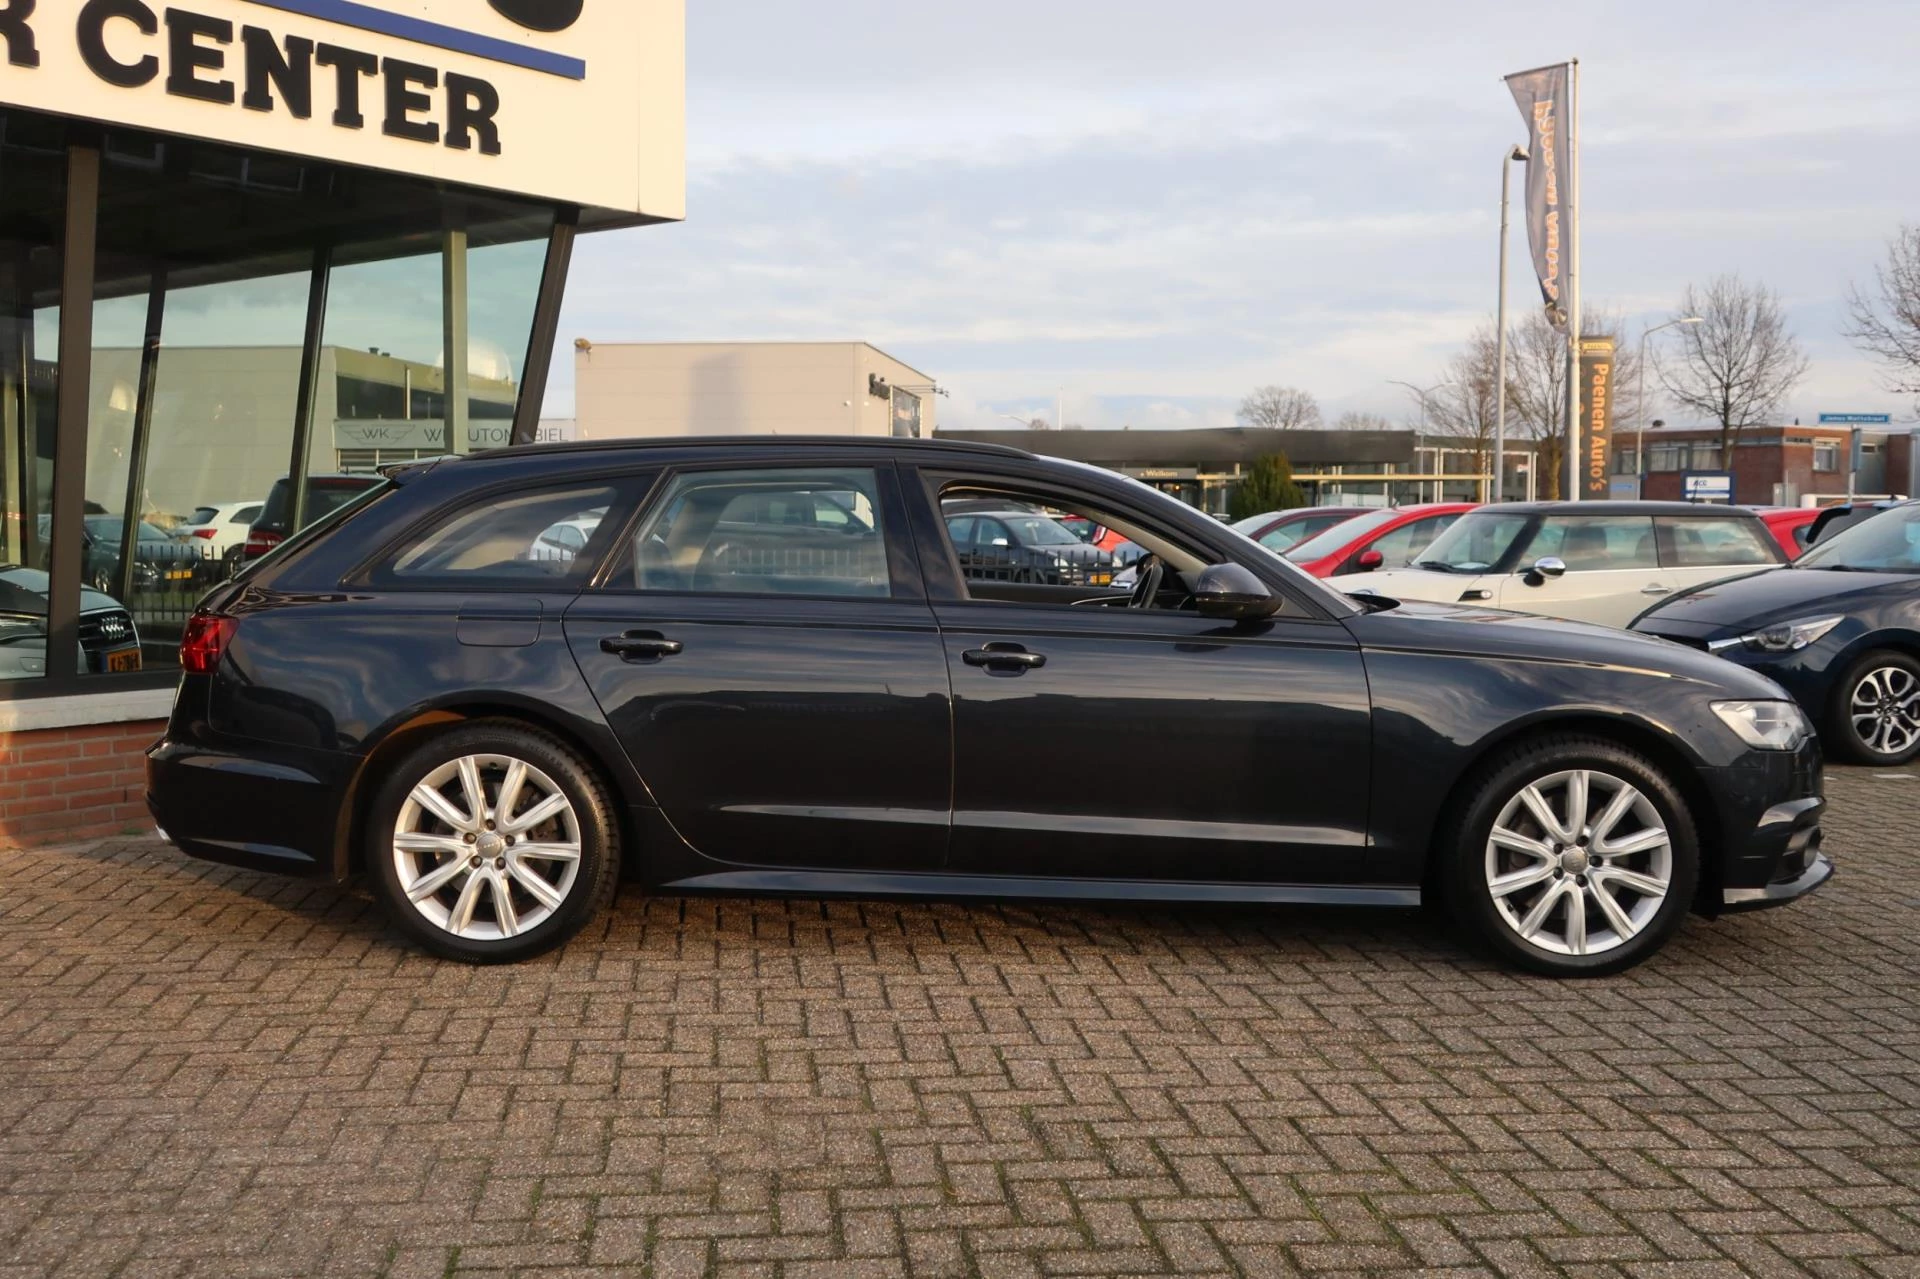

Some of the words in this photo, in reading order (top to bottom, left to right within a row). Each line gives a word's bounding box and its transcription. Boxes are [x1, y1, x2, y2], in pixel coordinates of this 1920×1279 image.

[76, 0, 502, 156] CENTER
[1591, 363, 1609, 431] Paenen
[362, 428, 390, 440] WK
[1590, 436, 1608, 491] Auto's
